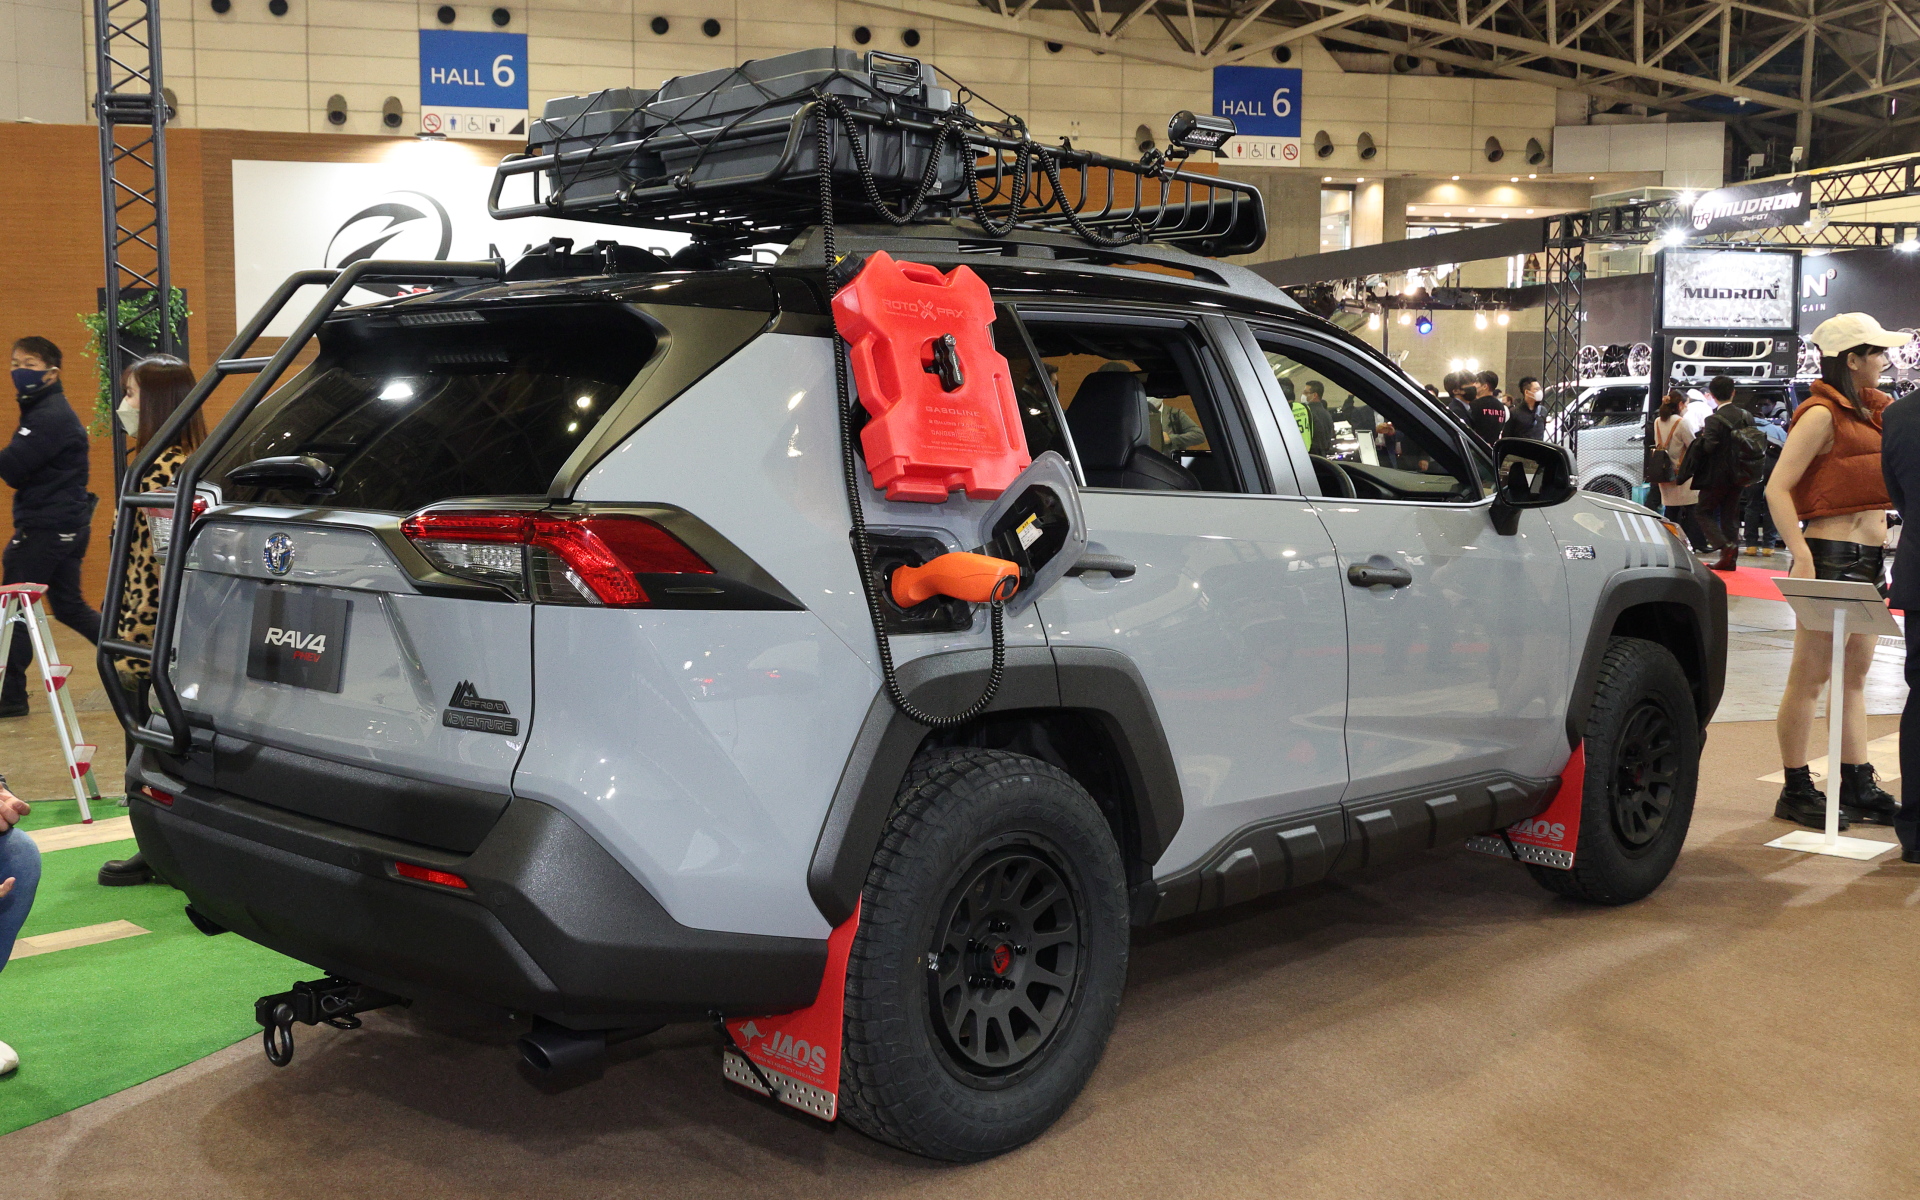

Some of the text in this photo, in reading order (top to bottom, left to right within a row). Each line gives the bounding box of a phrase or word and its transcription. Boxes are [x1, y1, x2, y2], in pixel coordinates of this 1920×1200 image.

[431, 54, 515, 87] HALL 6
[1222, 88, 1291, 117] HALL 6
[1713, 192, 1803, 219] MUDRON
[1684, 287, 1778, 300] MUDRON
[1802, 303, 1826, 313] GAIN
[925, 406, 981, 417] GASOLINE
[264, 627, 326, 653] RAV4
[463, 699, 504, 711] OFFROAD
[445, 712, 513, 732] ADVENTURE
[761, 1031, 827, 1075] JAOS
